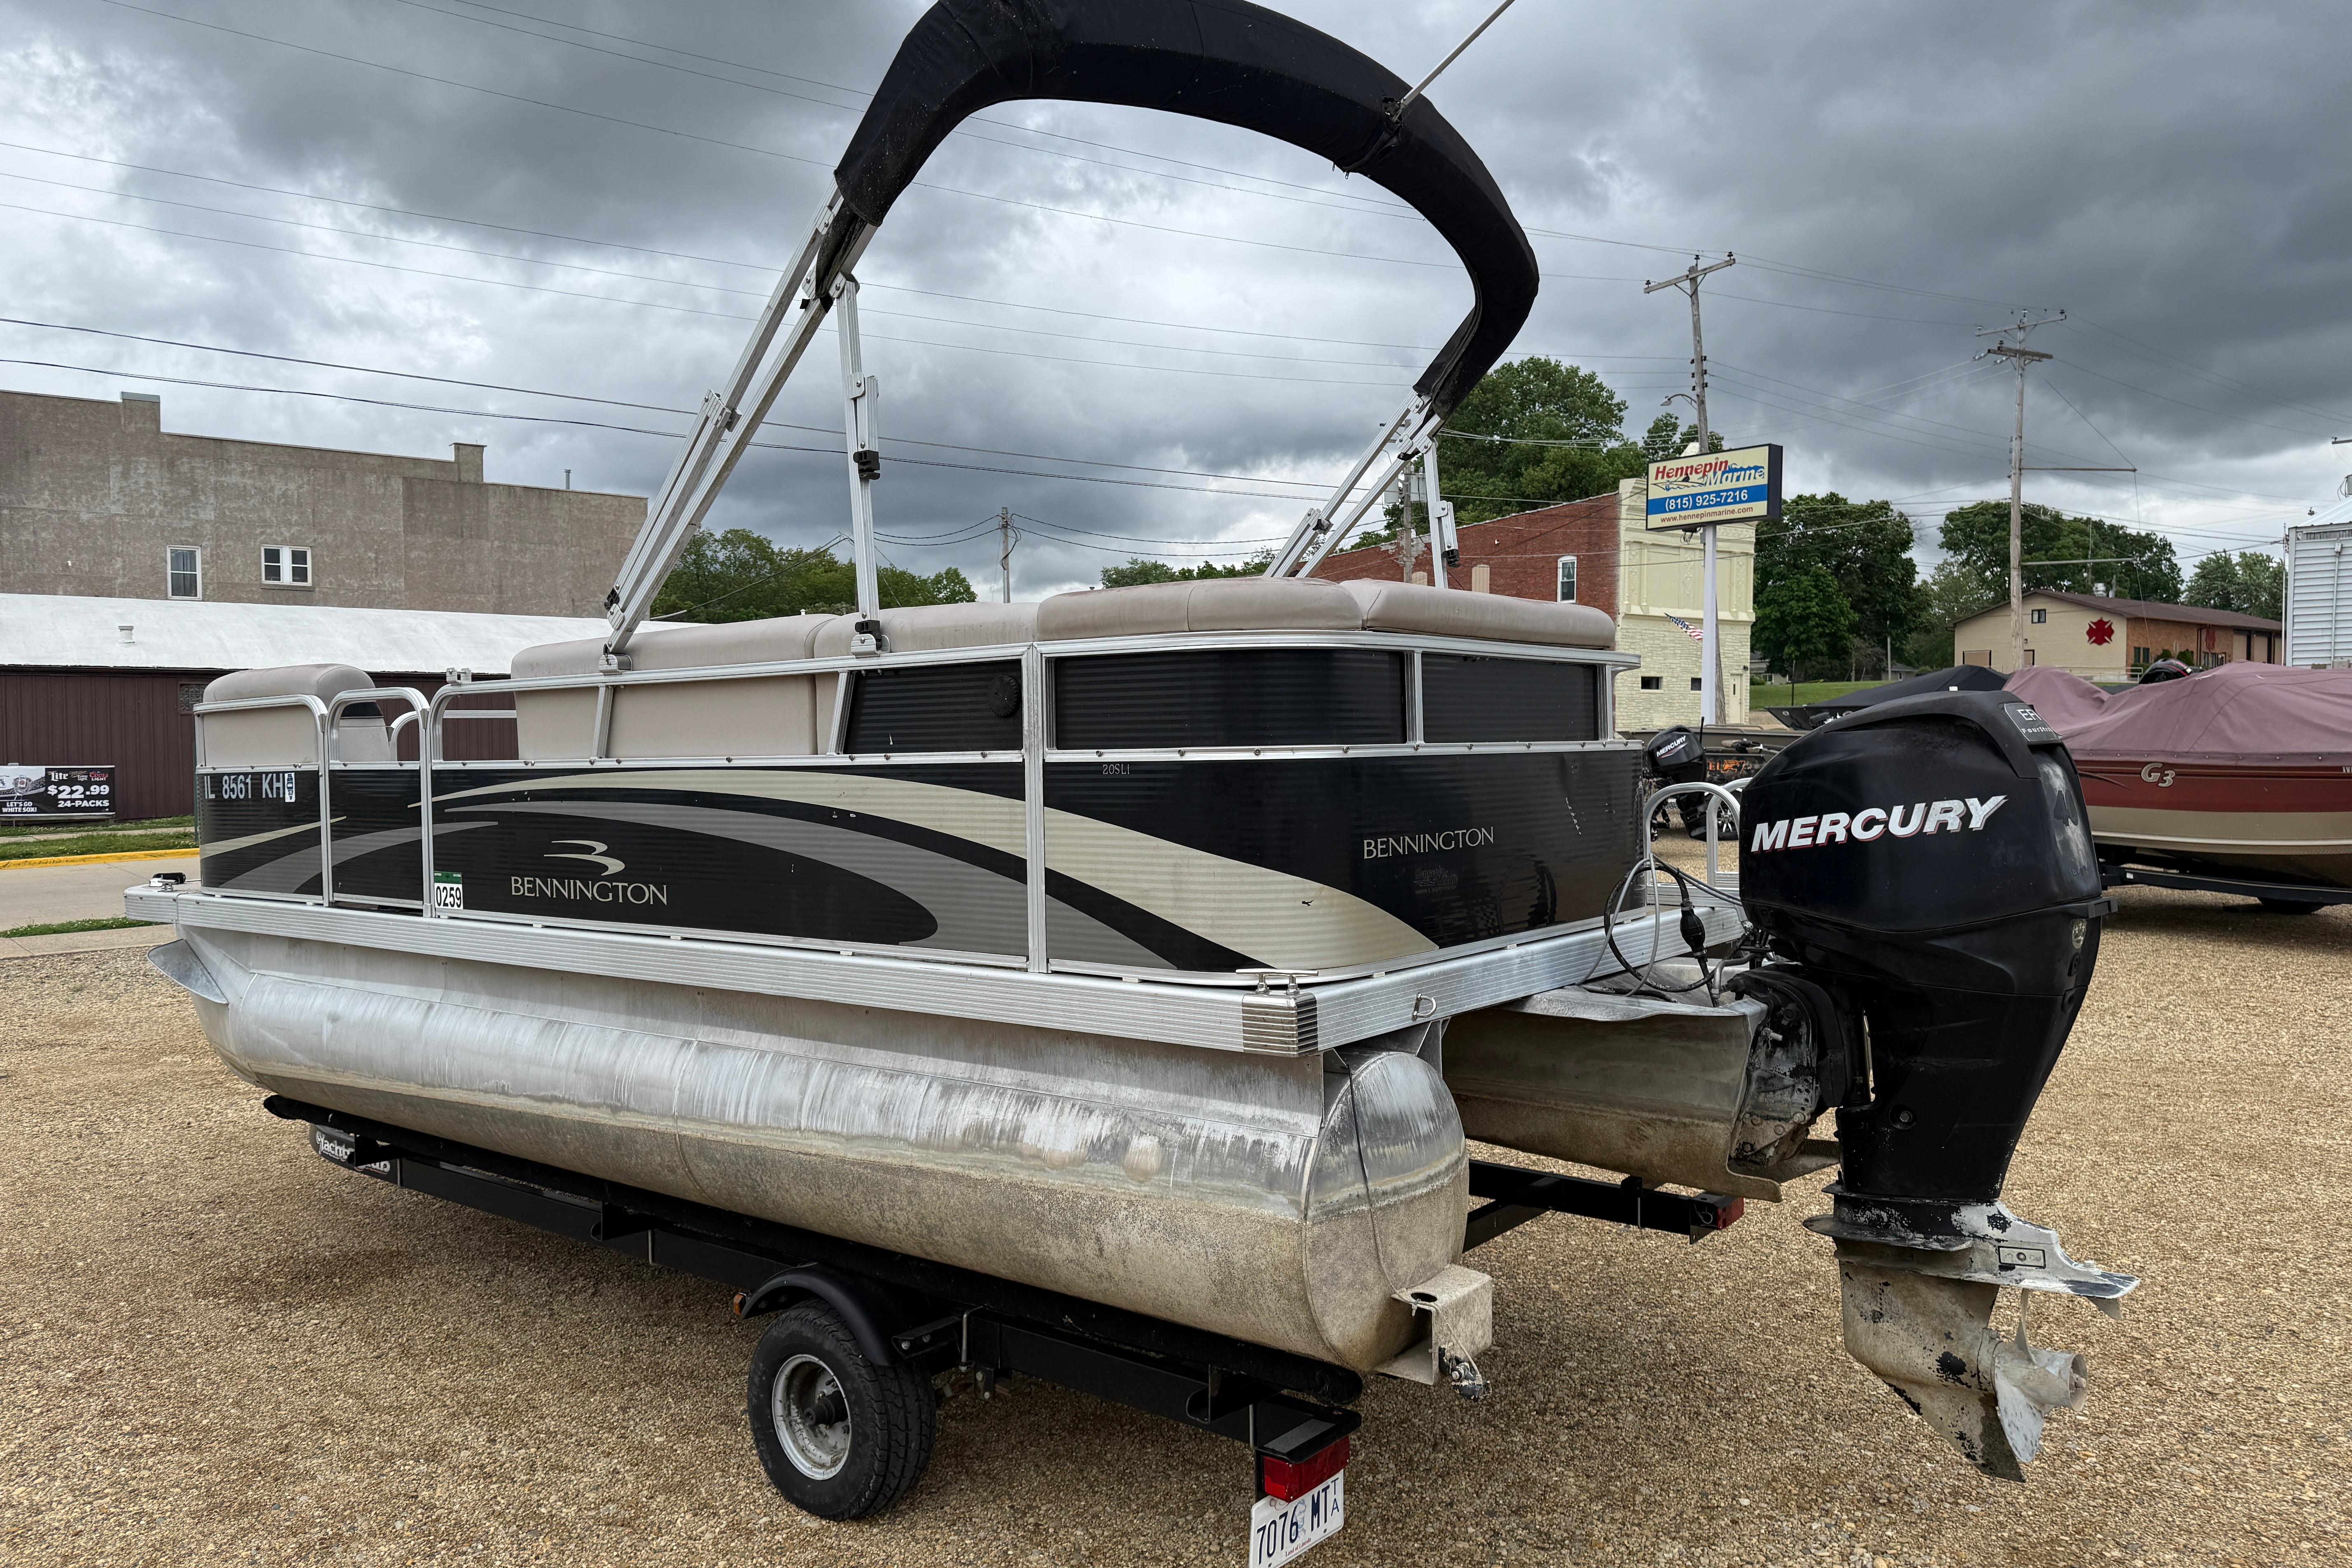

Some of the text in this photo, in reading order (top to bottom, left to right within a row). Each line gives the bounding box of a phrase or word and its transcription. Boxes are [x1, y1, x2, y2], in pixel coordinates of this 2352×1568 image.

[1654, 457, 1729, 481] Hennepin
[1705, 468, 1764, 487] Marine
[1665, 490, 1748, 511] (815) 925-7216
[1661, 506, 1753, 523] www.hennepinmarine.com
[2016, 709, 2042, 721] EFI
[1656, 735, 1686, 757] MERCURY
[50, 772, 68, 782] Lite
[2141, 762, 2175, 787] G3
[47, 784, 110, 799] $22.99
[204, 776, 216, 799] IL
[222, 775, 252, 799] 8561
[262, 773, 283, 798] KH
[1751, 795, 2009, 855] MERCURY
[1363, 826, 1493, 859] BENNINGTON
[436, 886, 462, 908] 0259
[511, 876, 667, 905] BENNINGTON
[1257, 1505, 1298, 1565] 7076
[1311, 1484, 1330, 1532] MT
